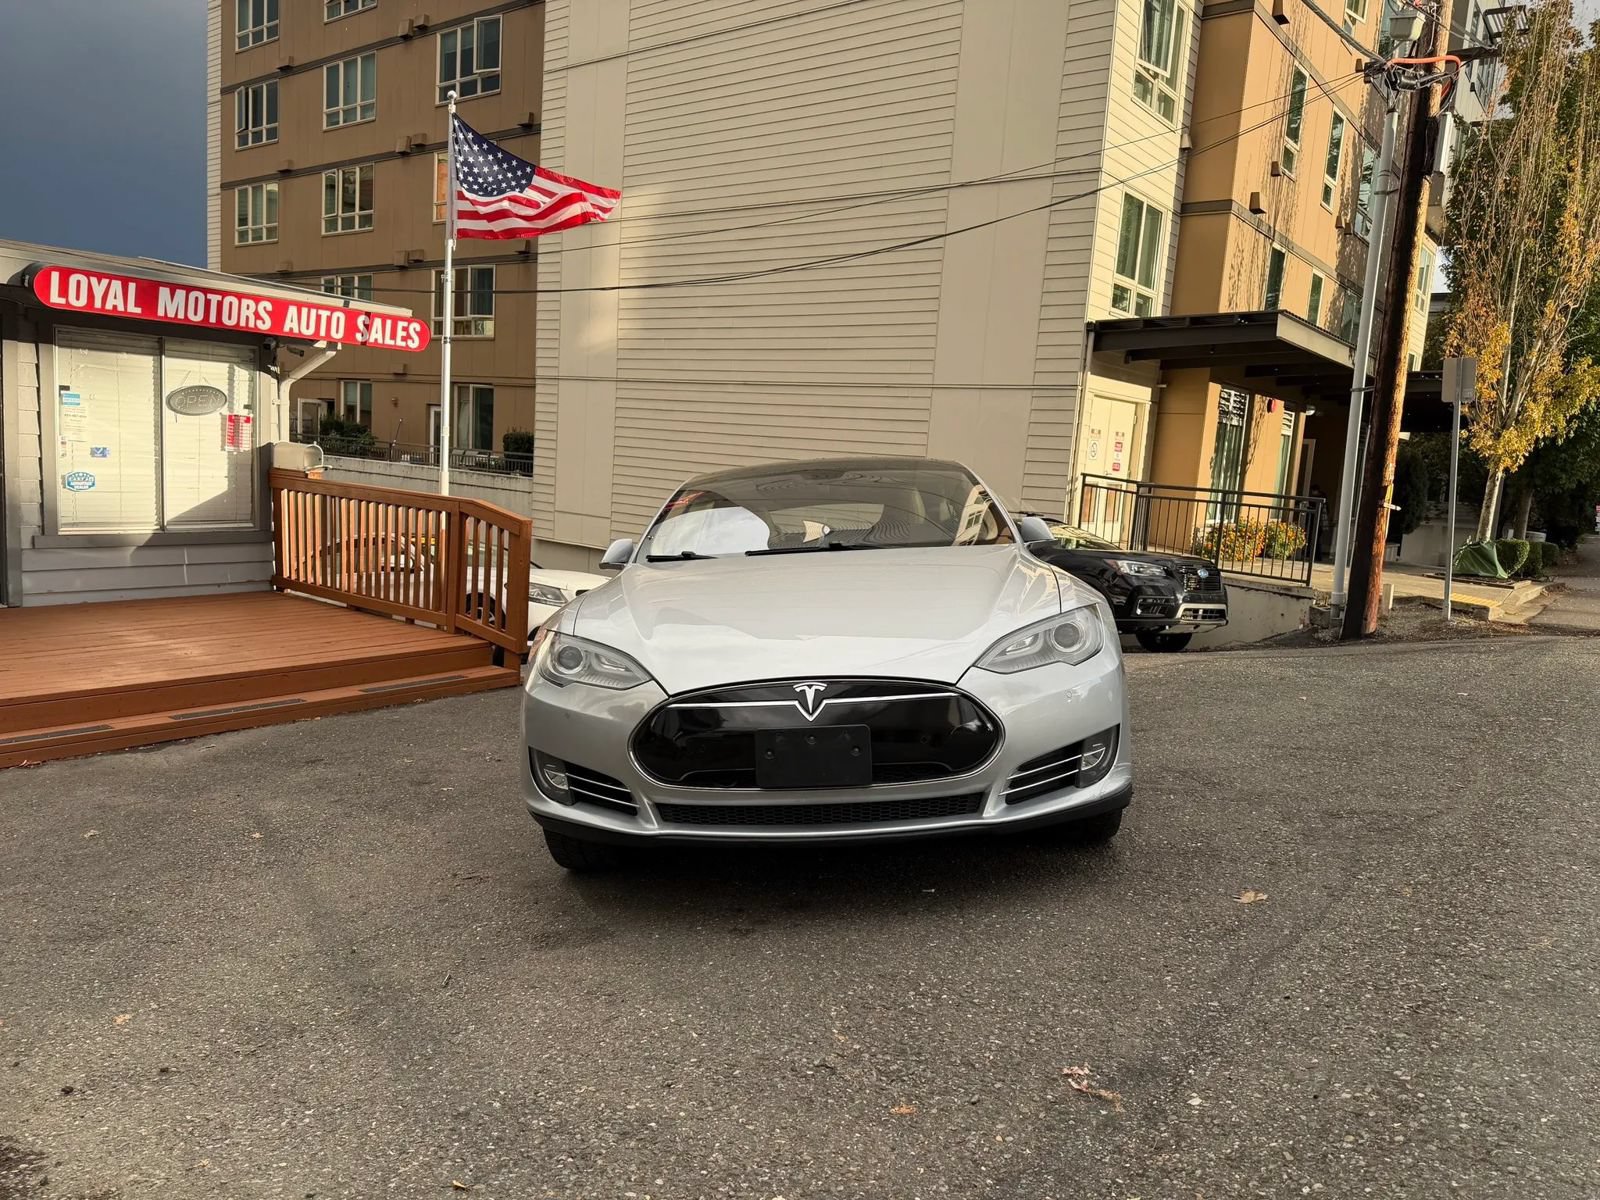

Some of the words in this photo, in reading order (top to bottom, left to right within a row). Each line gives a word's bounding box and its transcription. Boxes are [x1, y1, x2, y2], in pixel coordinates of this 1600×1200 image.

[49, 271, 142, 313] LOYAL
[157, 286, 273, 331] MOTORS
[283, 305, 346, 339] AUTO
[356, 314, 421, 349] SALES
[175, 394, 219, 410] OPEN
